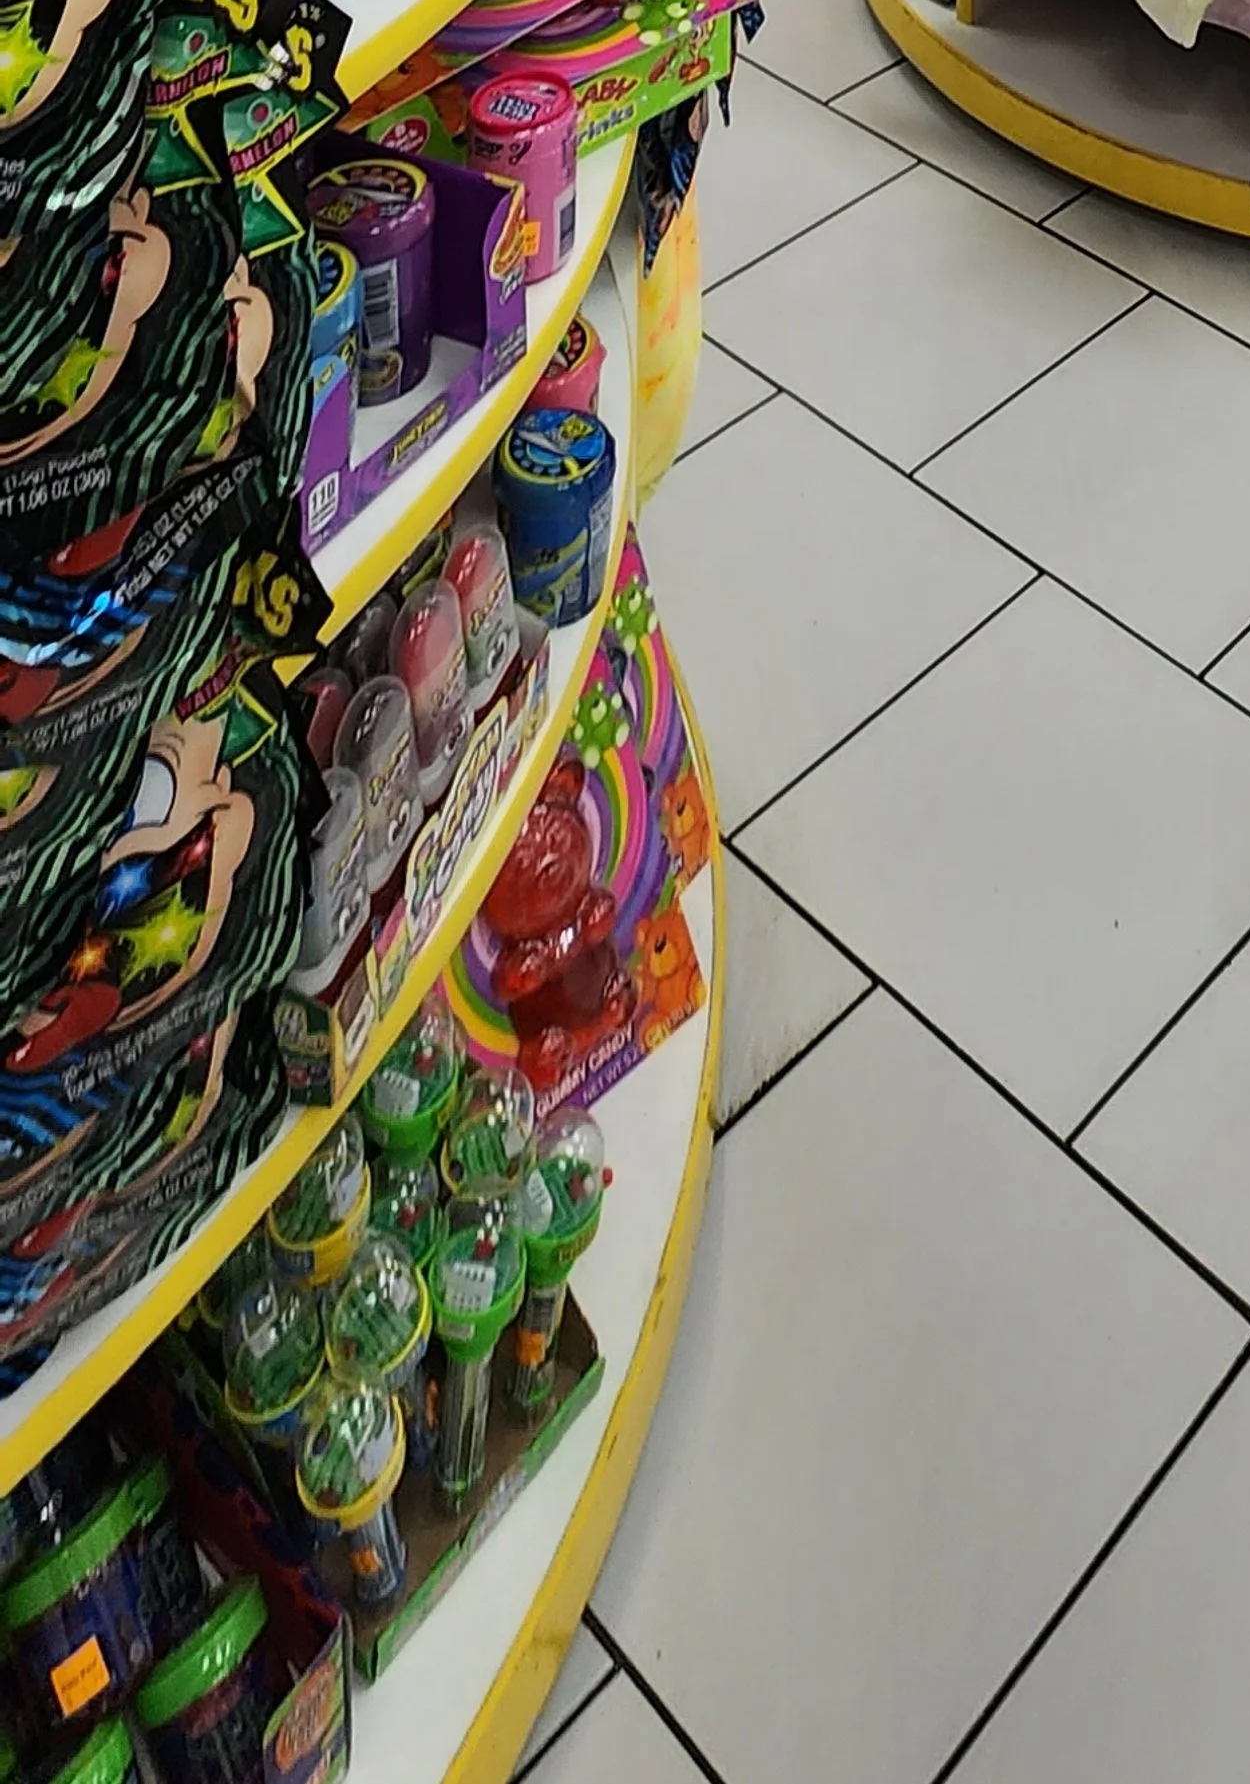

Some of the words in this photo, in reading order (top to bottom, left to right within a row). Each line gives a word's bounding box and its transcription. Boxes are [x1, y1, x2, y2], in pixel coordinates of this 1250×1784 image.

[51, 478, 72, 499] OZ
[310, 477, 337, 510] 110
[536, 1062, 587, 1119] GUMMY
[588, 1019, 634, 1072] CANDY
